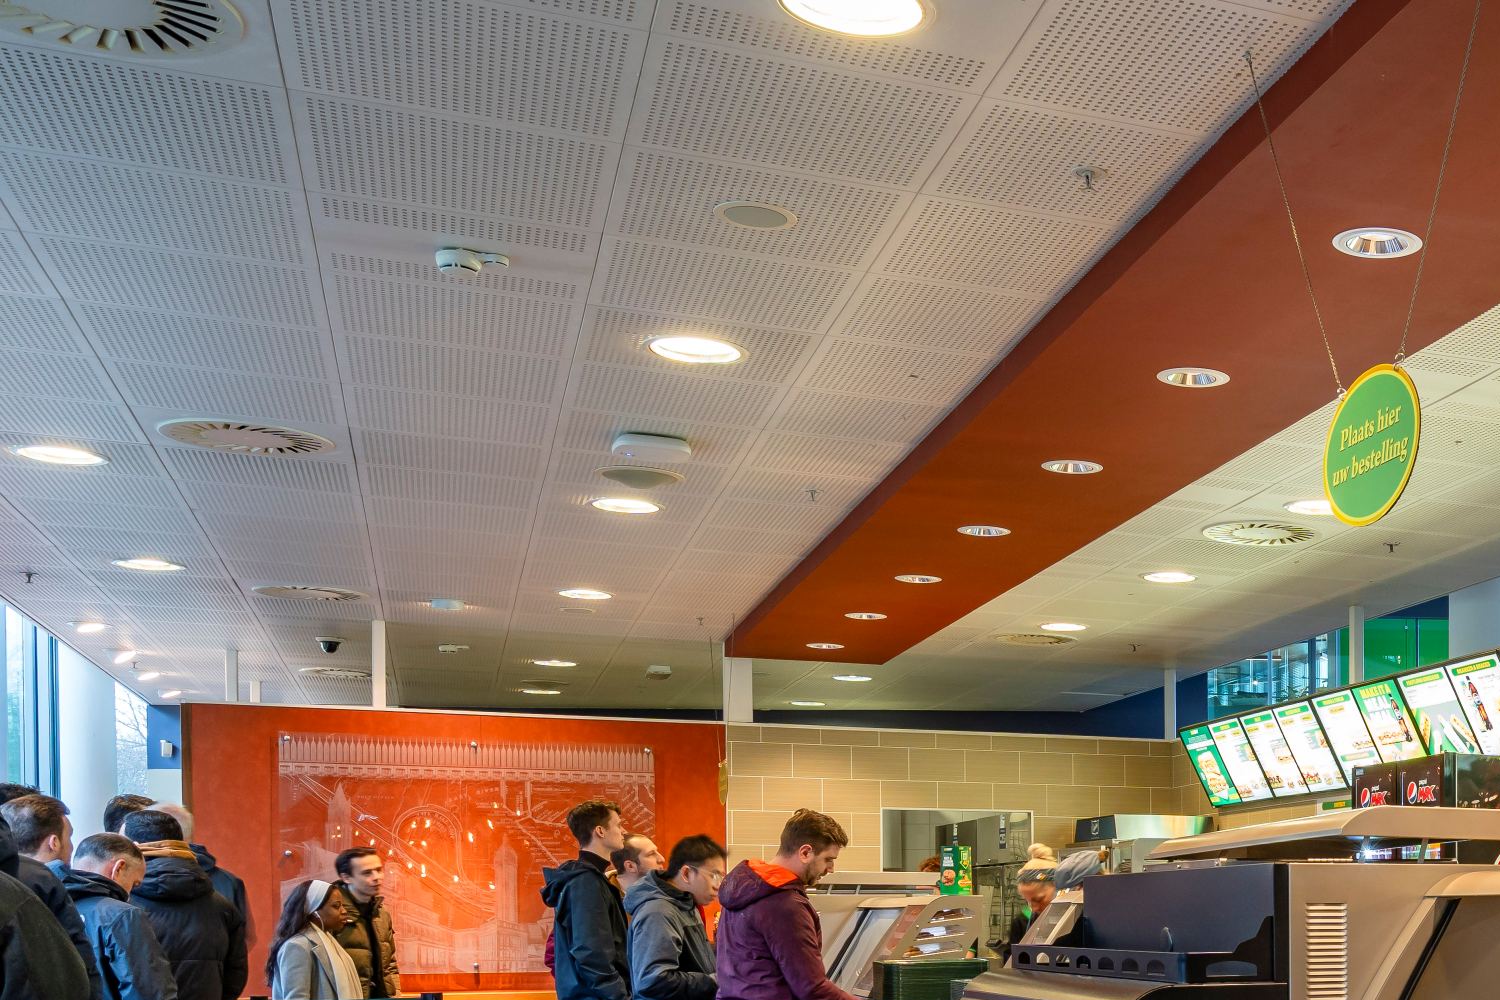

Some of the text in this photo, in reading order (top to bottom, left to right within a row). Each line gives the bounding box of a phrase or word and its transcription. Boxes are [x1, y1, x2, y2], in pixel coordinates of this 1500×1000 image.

[1339, 405, 1402, 452] Plaats hier
[1332, 437, 1409, 487] uw bestelling
